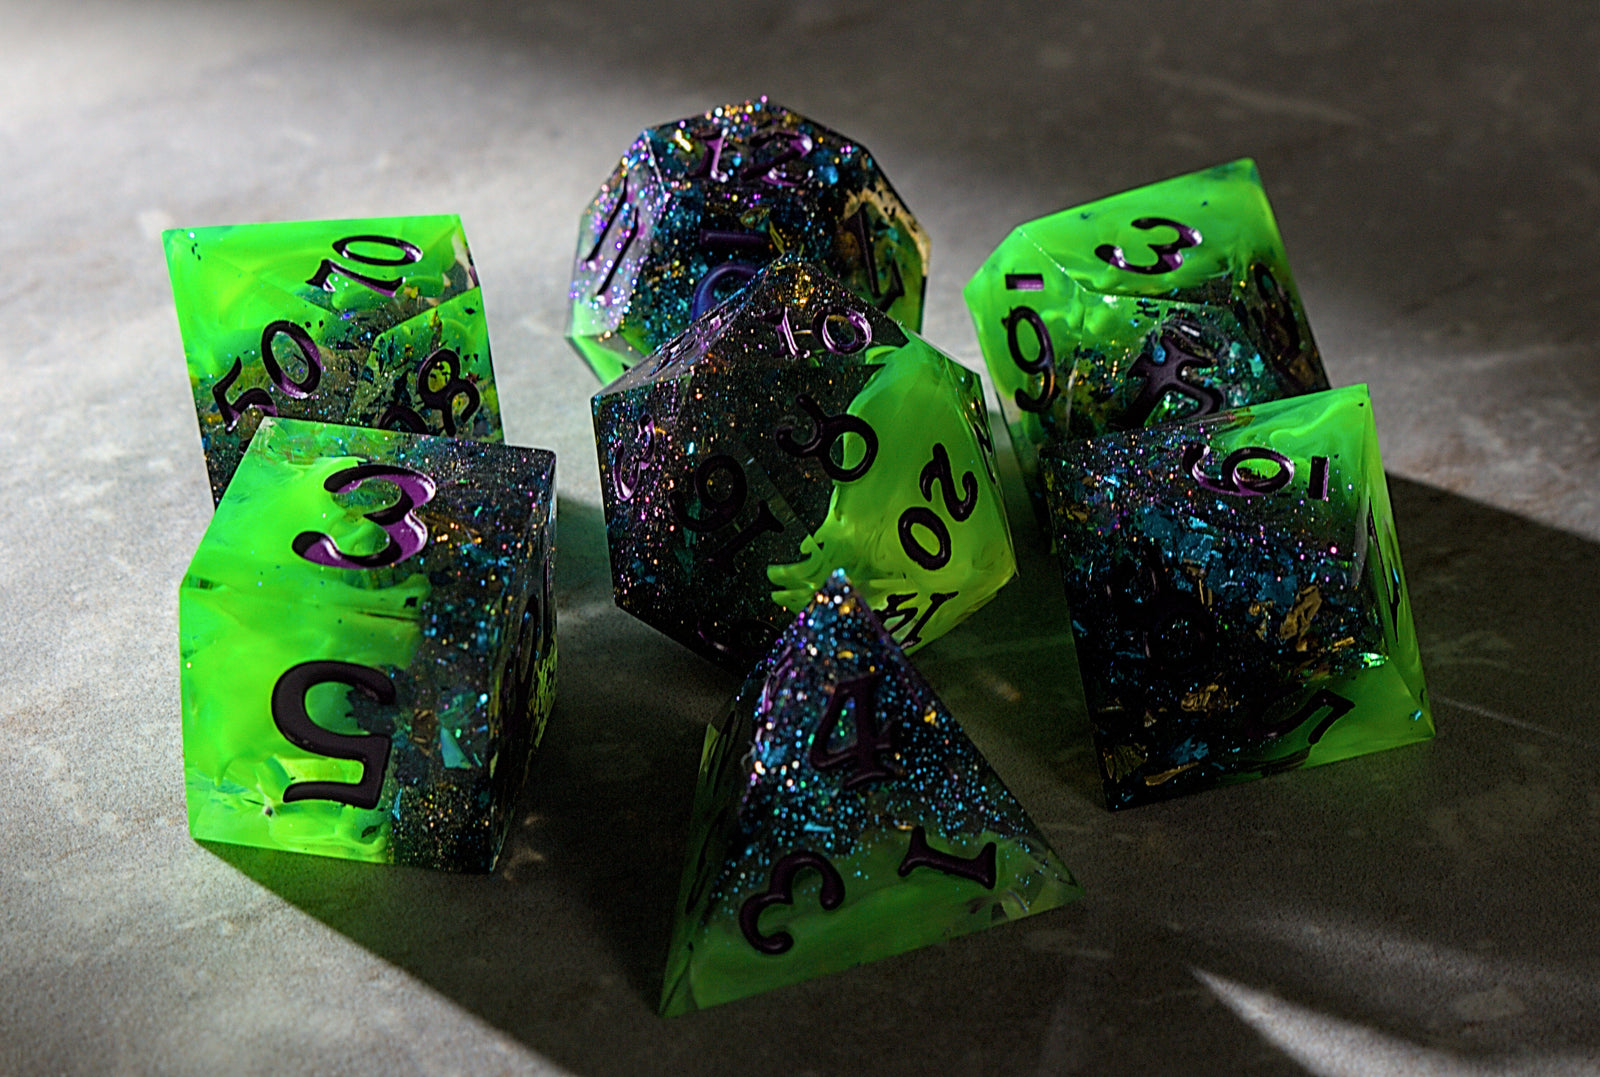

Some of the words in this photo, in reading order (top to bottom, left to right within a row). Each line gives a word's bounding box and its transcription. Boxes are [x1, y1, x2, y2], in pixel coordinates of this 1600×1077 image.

[688, 128, 814, 187] 12
[1094, 217, 1202, 274] 3
[757, 305, 873, 359] 10
[212, 320, 321, 453] 50
[775, 393, 878, 482] 8
[612, 412, 657, 501] 3
[898, 442, 978, 571] 20
[292, 464, 436, 570] 3
[668, 454, 784, 574] 16
[271, 660, 396, 809] 5
[809, 673, 901, 790] 4
[739, 851, 845, 954] 3
[899, 827, 996, 889] 1
